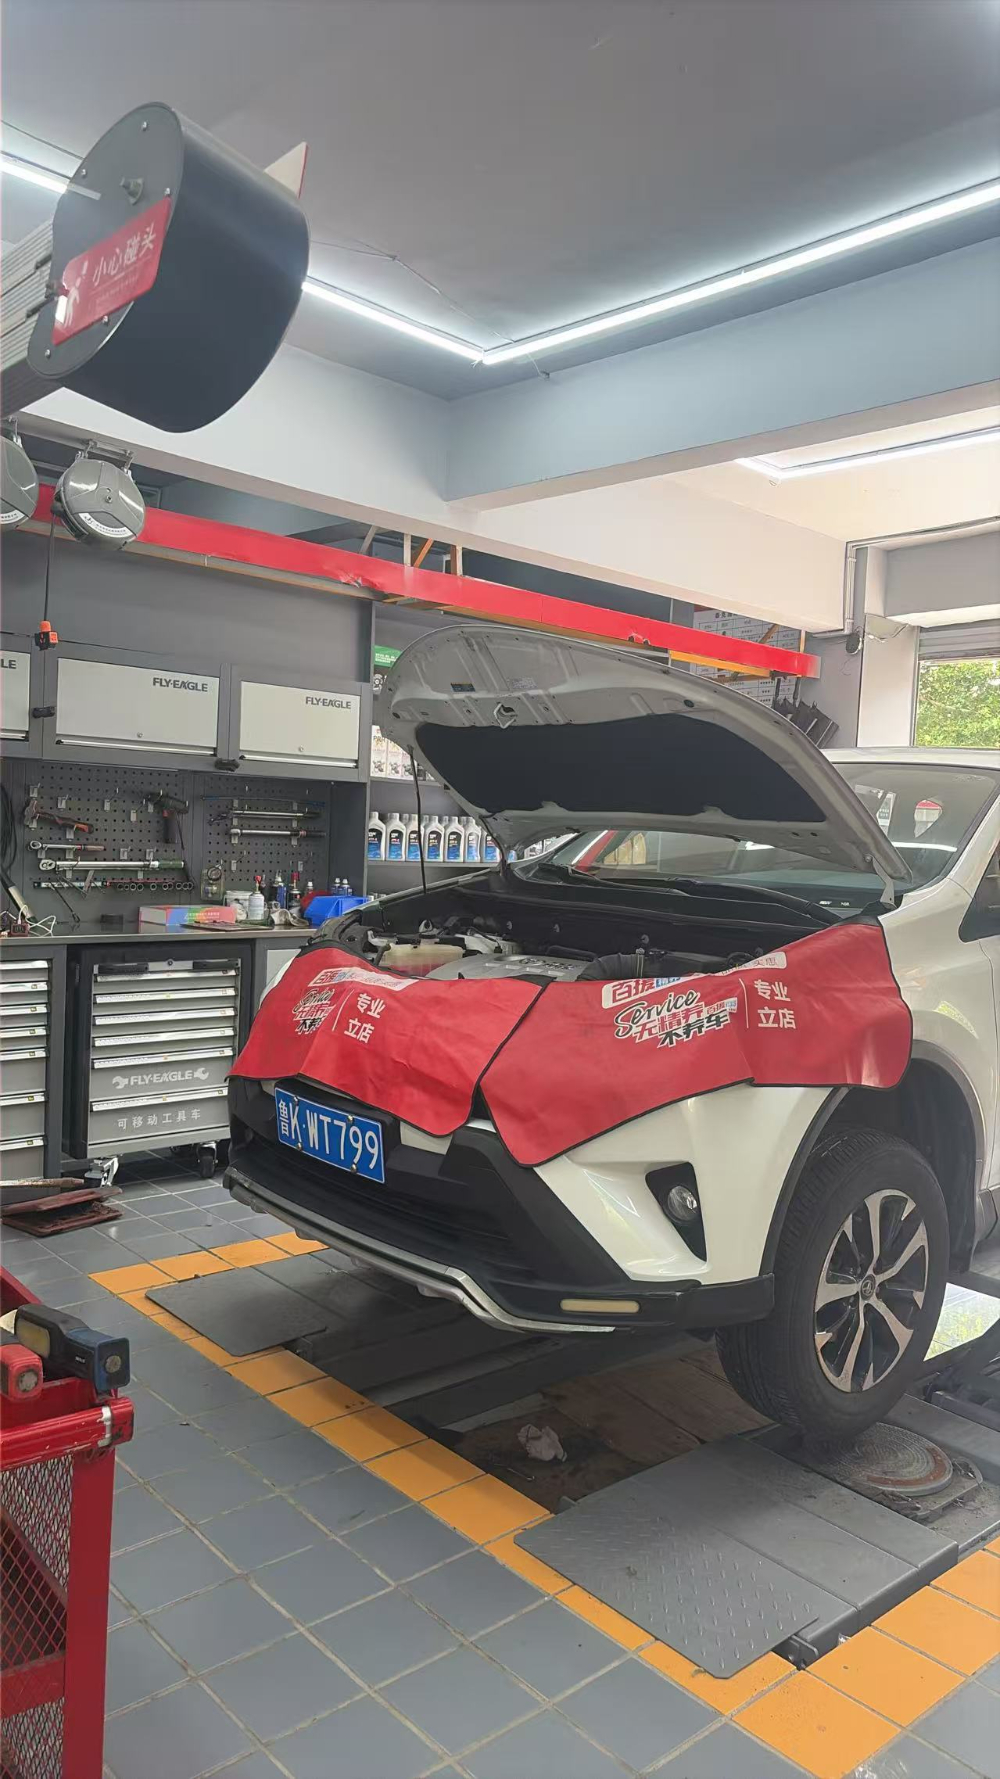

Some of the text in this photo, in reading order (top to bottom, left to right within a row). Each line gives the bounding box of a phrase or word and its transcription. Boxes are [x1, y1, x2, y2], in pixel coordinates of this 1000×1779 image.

[92, 221, 156, 287] 小心碰头
[754, 979, 791, 1002] 专业
[357, 993, 386, 1018] 专业
[614, 989, 700, 1038] Service
[757, 1006, 796, 1029] 立店
[344, 1018, 375, 1043] 立店
[658, 1008, 730, 1047] 不养车
[117, 1109, 201, 1130] 可移动工具车
